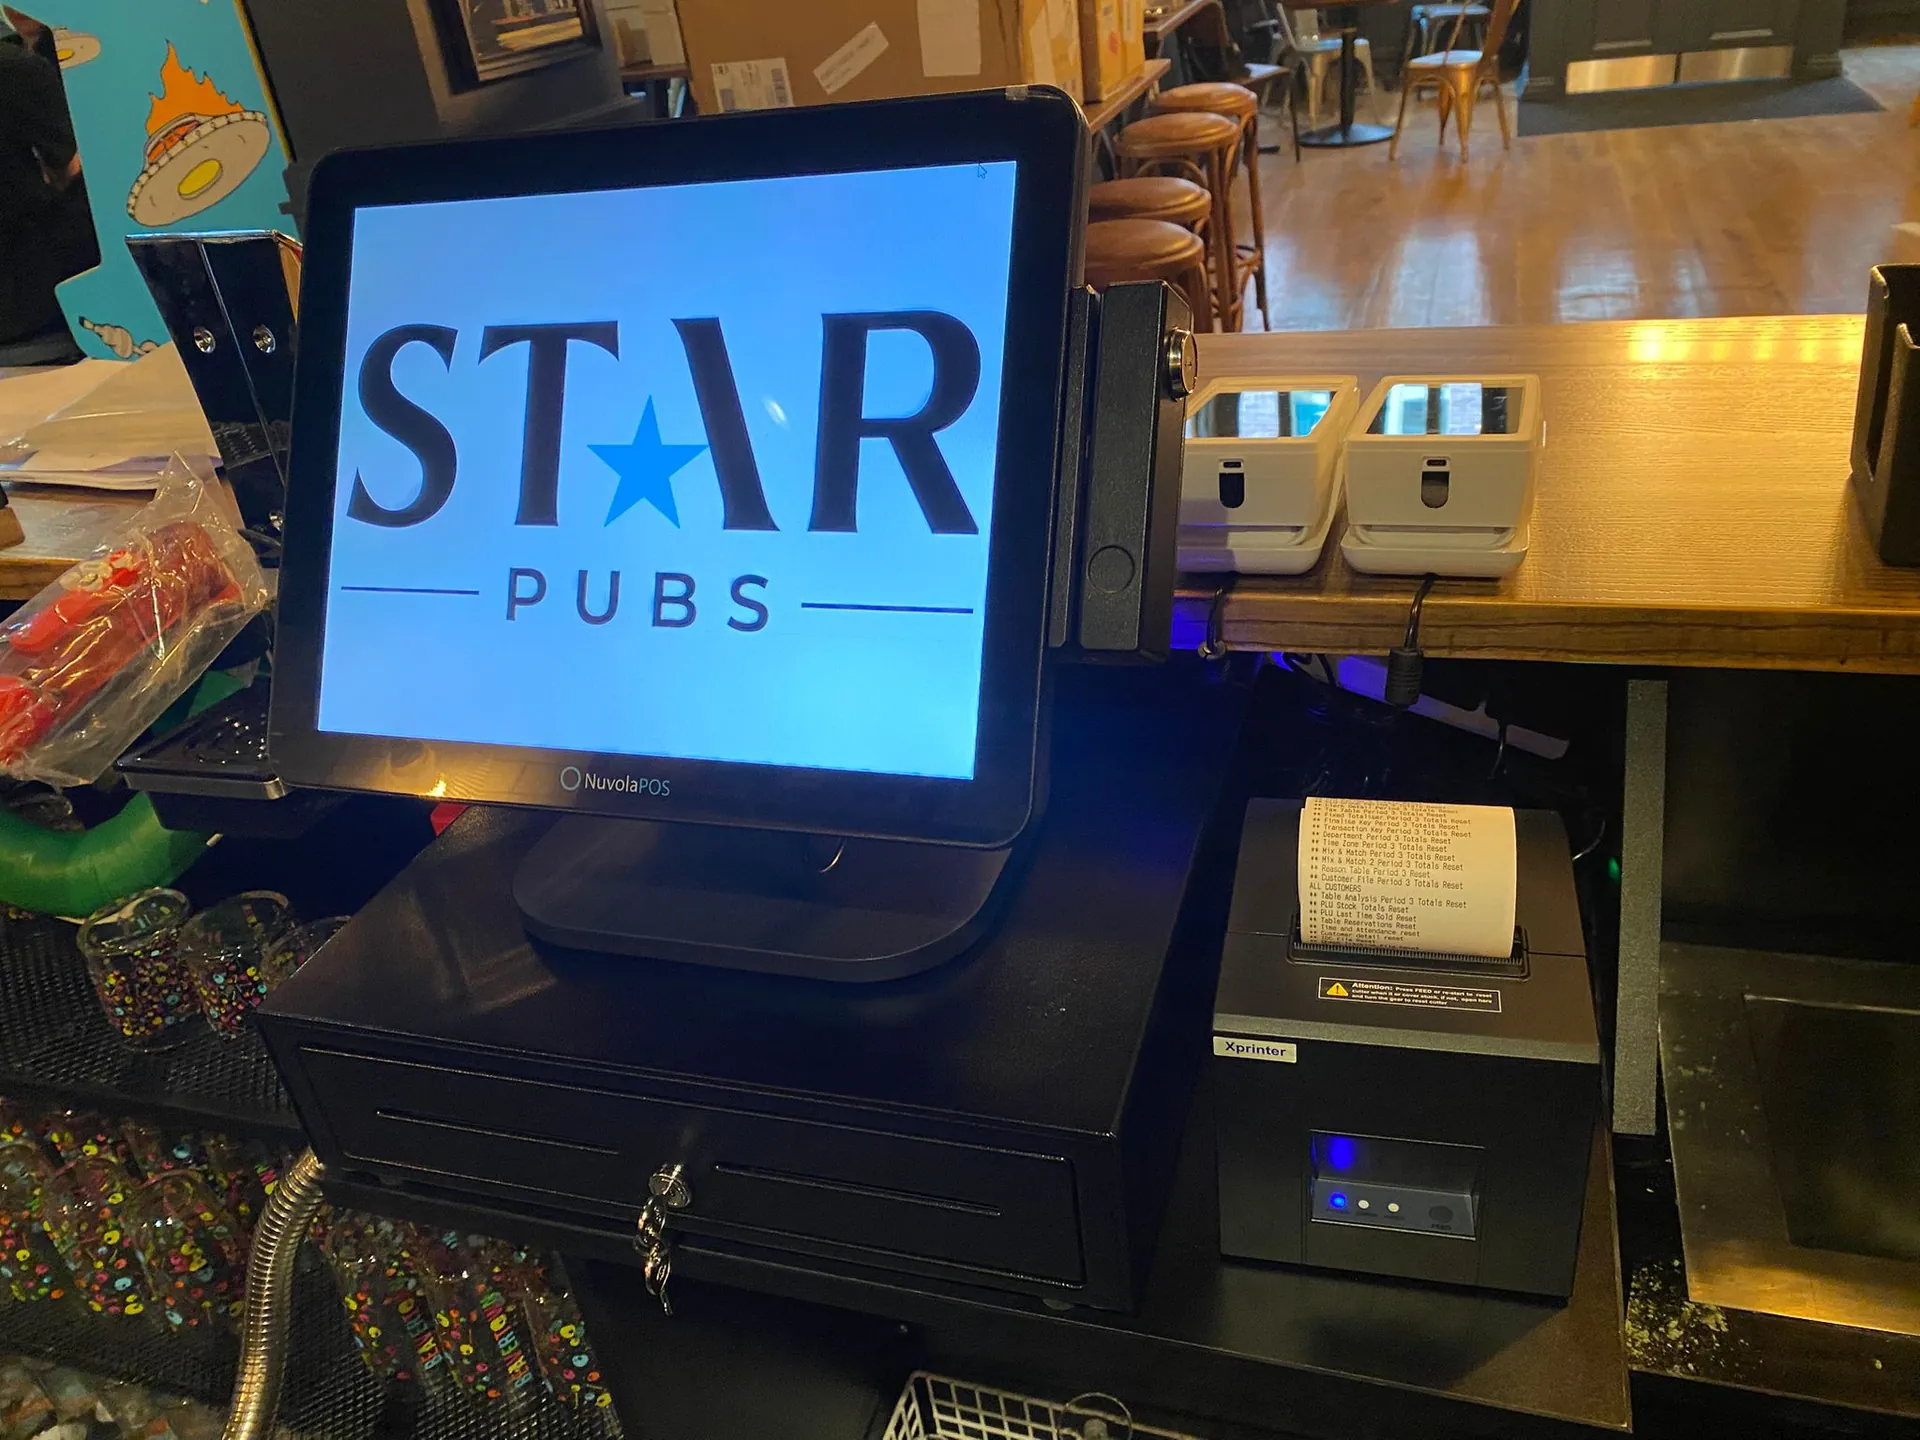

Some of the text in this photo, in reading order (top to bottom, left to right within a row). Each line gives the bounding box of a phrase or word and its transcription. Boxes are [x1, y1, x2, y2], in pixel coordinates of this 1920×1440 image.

[346, 309, 982, 535] STAR
[506, 567, 770, 632] PUBS
[584, 773, 671, 796] NuvolaPOS
[1324, 824, 1367, 832] Transaction
[1323, 831, 1362, 839] Department
[1362, 841, 1387, 849] Period
[1399, 843, 1423, 851] Totals
[1370, 850, 1394, 858] Period
[1407, 852, 1431, 860] Totals
[1435, 853, 1455, 861] Reset
[1322, 864, 1346, 873] Reason
[1350, 866, 1370, 874] Table
[1374, 868, 1398, 876] Period
[1402, 869, 1406, 877] 3
[1410, 870, 1430, 878] Reset
[1415, 861, 1439, 869] Totals
[1443, 862, 1463, 871] Reset
[1309, 882, 1361, 892] ALL CUSTOMERS
[1322, 874, 1352, 882] Customer
[1358, 876, 1373, 884] File
[1377, 877, 1402, 886] Period
[1415, 879, 1439, 888] Totals
[1443, 881, 1463, 890] Reset
[1322, 892, 1341, 900] Table
[1345, 894, 1377, 902] Analysis
[1381, 896, 1405, 904] Period
[1418, 898, 1442, 907] Totals
[1446, 900, 1466, 908] Reset
[1337, 902, 1356, 910] Stock
[1361, 904, 1385, 912] Totals
[1388, 905, 1408, 913] Reset
[1357, 911, 1372, 919] Time
[1396, 914, 1416, 922] Reset
[1344, 919, 1392, 928] Reservations
[1356, 927, 1396, 935] Attendance
[1352, 982, 1393, 990] Attention:
[1225, 1041, 1287, 1057] Xprinter
